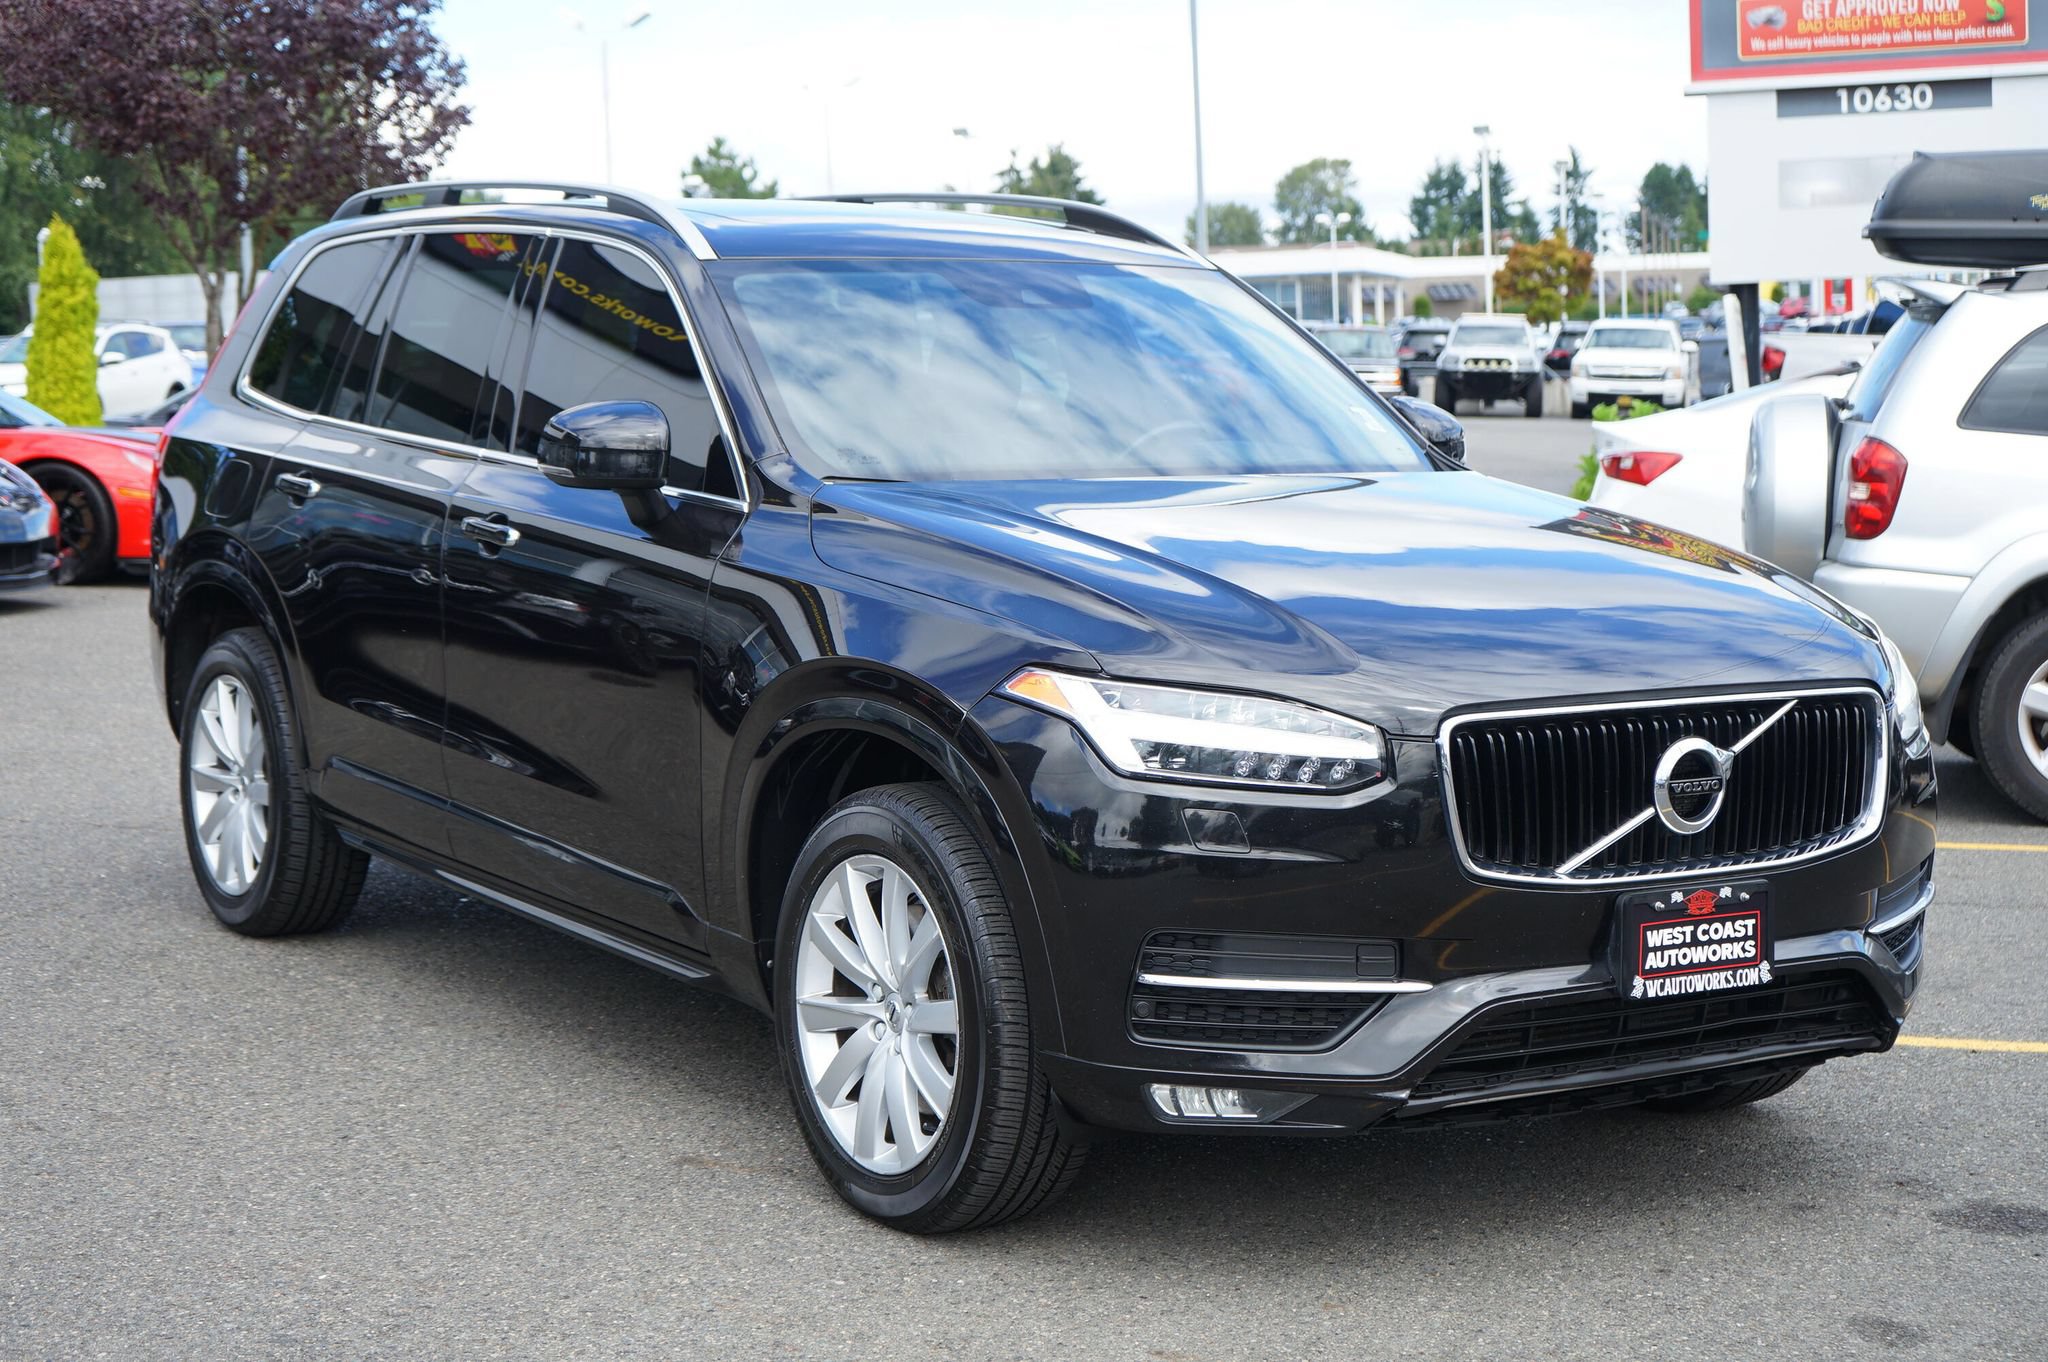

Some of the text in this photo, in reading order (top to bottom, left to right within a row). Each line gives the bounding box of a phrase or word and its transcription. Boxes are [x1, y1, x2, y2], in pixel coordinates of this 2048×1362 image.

[1797, 10, 1965, 34] BAD CREDIT WE CAN HELP
[1803, 0, 1961, 20] GET APPROVED NOW
[1750, 36, 1766, 52] We
[1767, 34, 1785, 50] sell
[1785, 34, 1812, 51] luxury
[1812, 31, 1850, 48] vehicles
[1850, 32, 1860, 46] to
[1861, 29, 1891, 48] people
[1892, 28, 1912, 44] with
[1914, 27, 1932, 42] less
[1934, 25, 1953, 41] than
[1954, 23, 1985, 43] perfect
[1835, 83, 1934, 114] 10630
[1671, 780, 1720, 792] VOLVO
[1646, 919, 1756, 948] WEST COAST
[1645, 940, 1756, 969] AUTOWORKS
[1644, 968, 1760, 998] WCAUTOWORKS.COM
